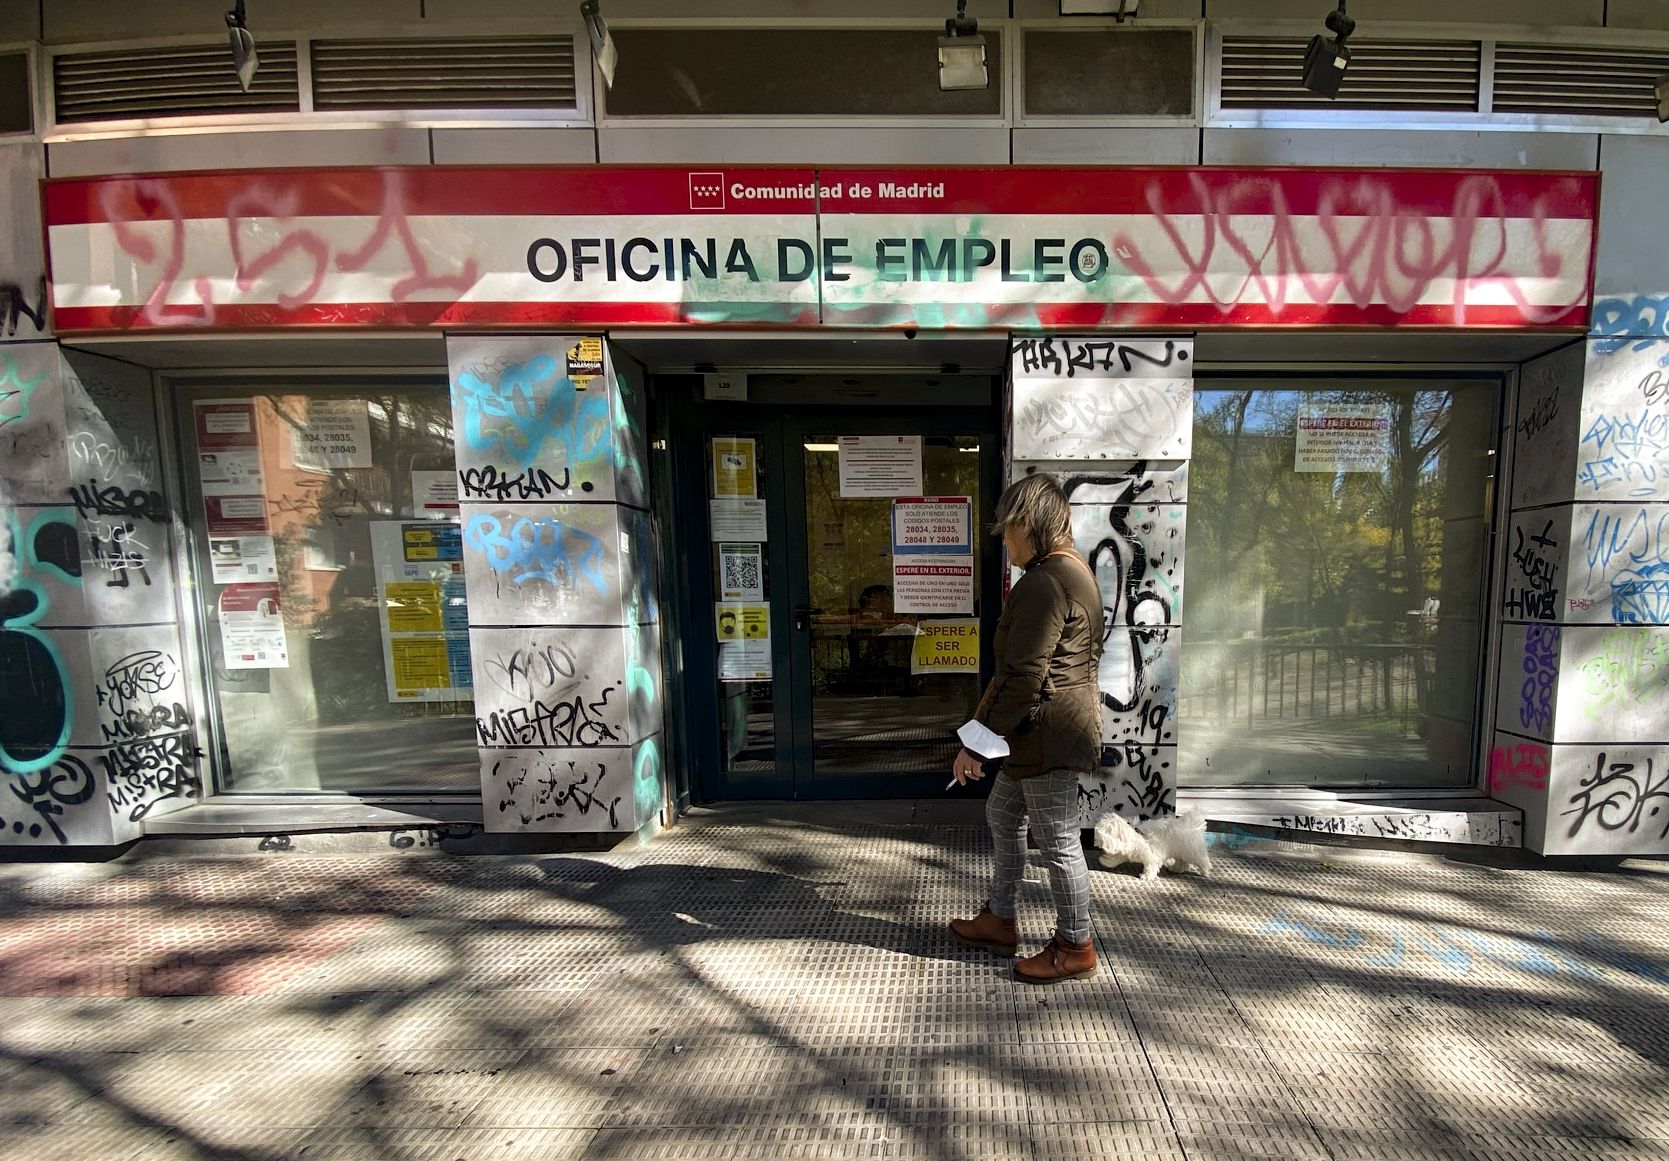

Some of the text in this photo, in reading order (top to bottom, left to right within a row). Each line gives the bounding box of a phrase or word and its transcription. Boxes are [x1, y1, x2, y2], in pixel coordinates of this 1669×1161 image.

[730, 182, 945, 200] Comunidad de Madrid
[526, 236, 1110, 284] OFICINA DE EMPLEO
[330, 446, 356, 454] 28049
[906, 526, 958, 534] 28034, 28035,
[904, 536, 927, 544] 28048
[936, 536, 960, 544] 28049
[969, 626, 978, 636] A
[935, 641, 961, 651] SER
[918, 656, 977, 666] LLAMADO
